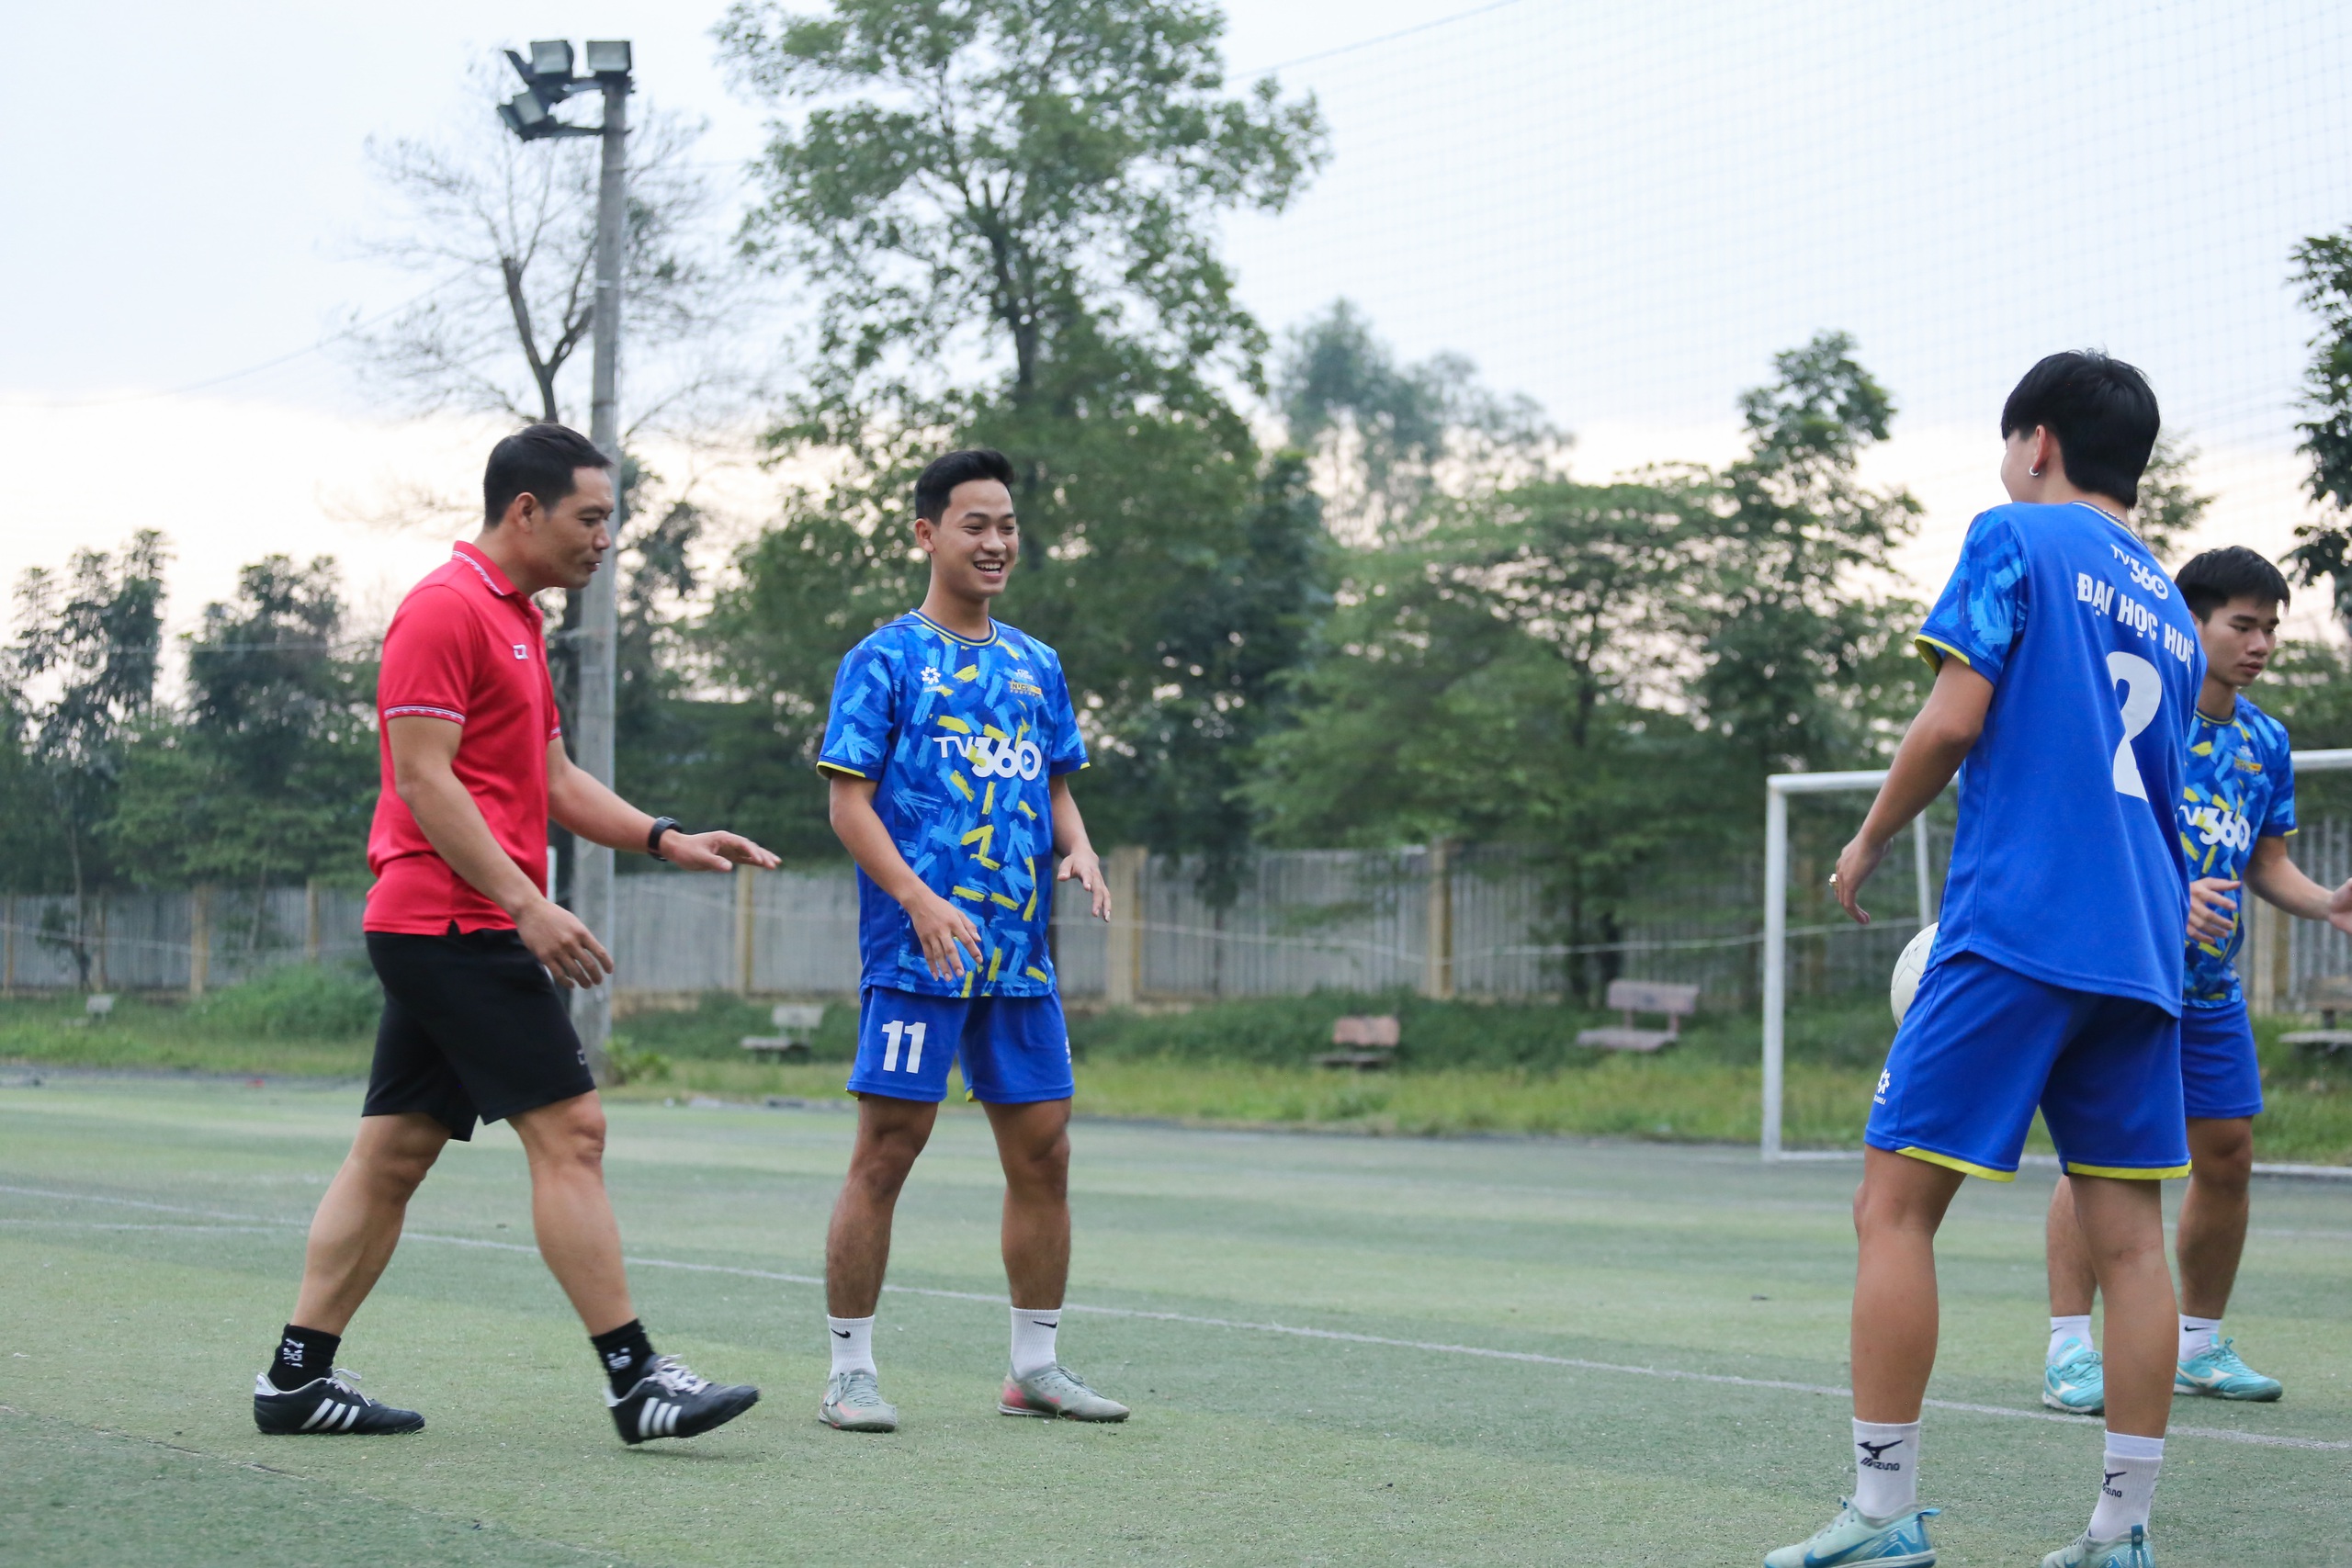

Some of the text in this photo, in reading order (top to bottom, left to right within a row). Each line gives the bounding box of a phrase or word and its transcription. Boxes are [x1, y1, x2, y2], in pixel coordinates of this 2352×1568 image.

[2110, 544, 2168, 600] TV360
[2077, 572, 2115, 616] ĐẠI
[2117, 593, 2158, 641] HỌC
[2106, 651, 2162, 803] 2
[933, 736, 1043, 781] TV360
[882, 1020, 927, 1074] 11
